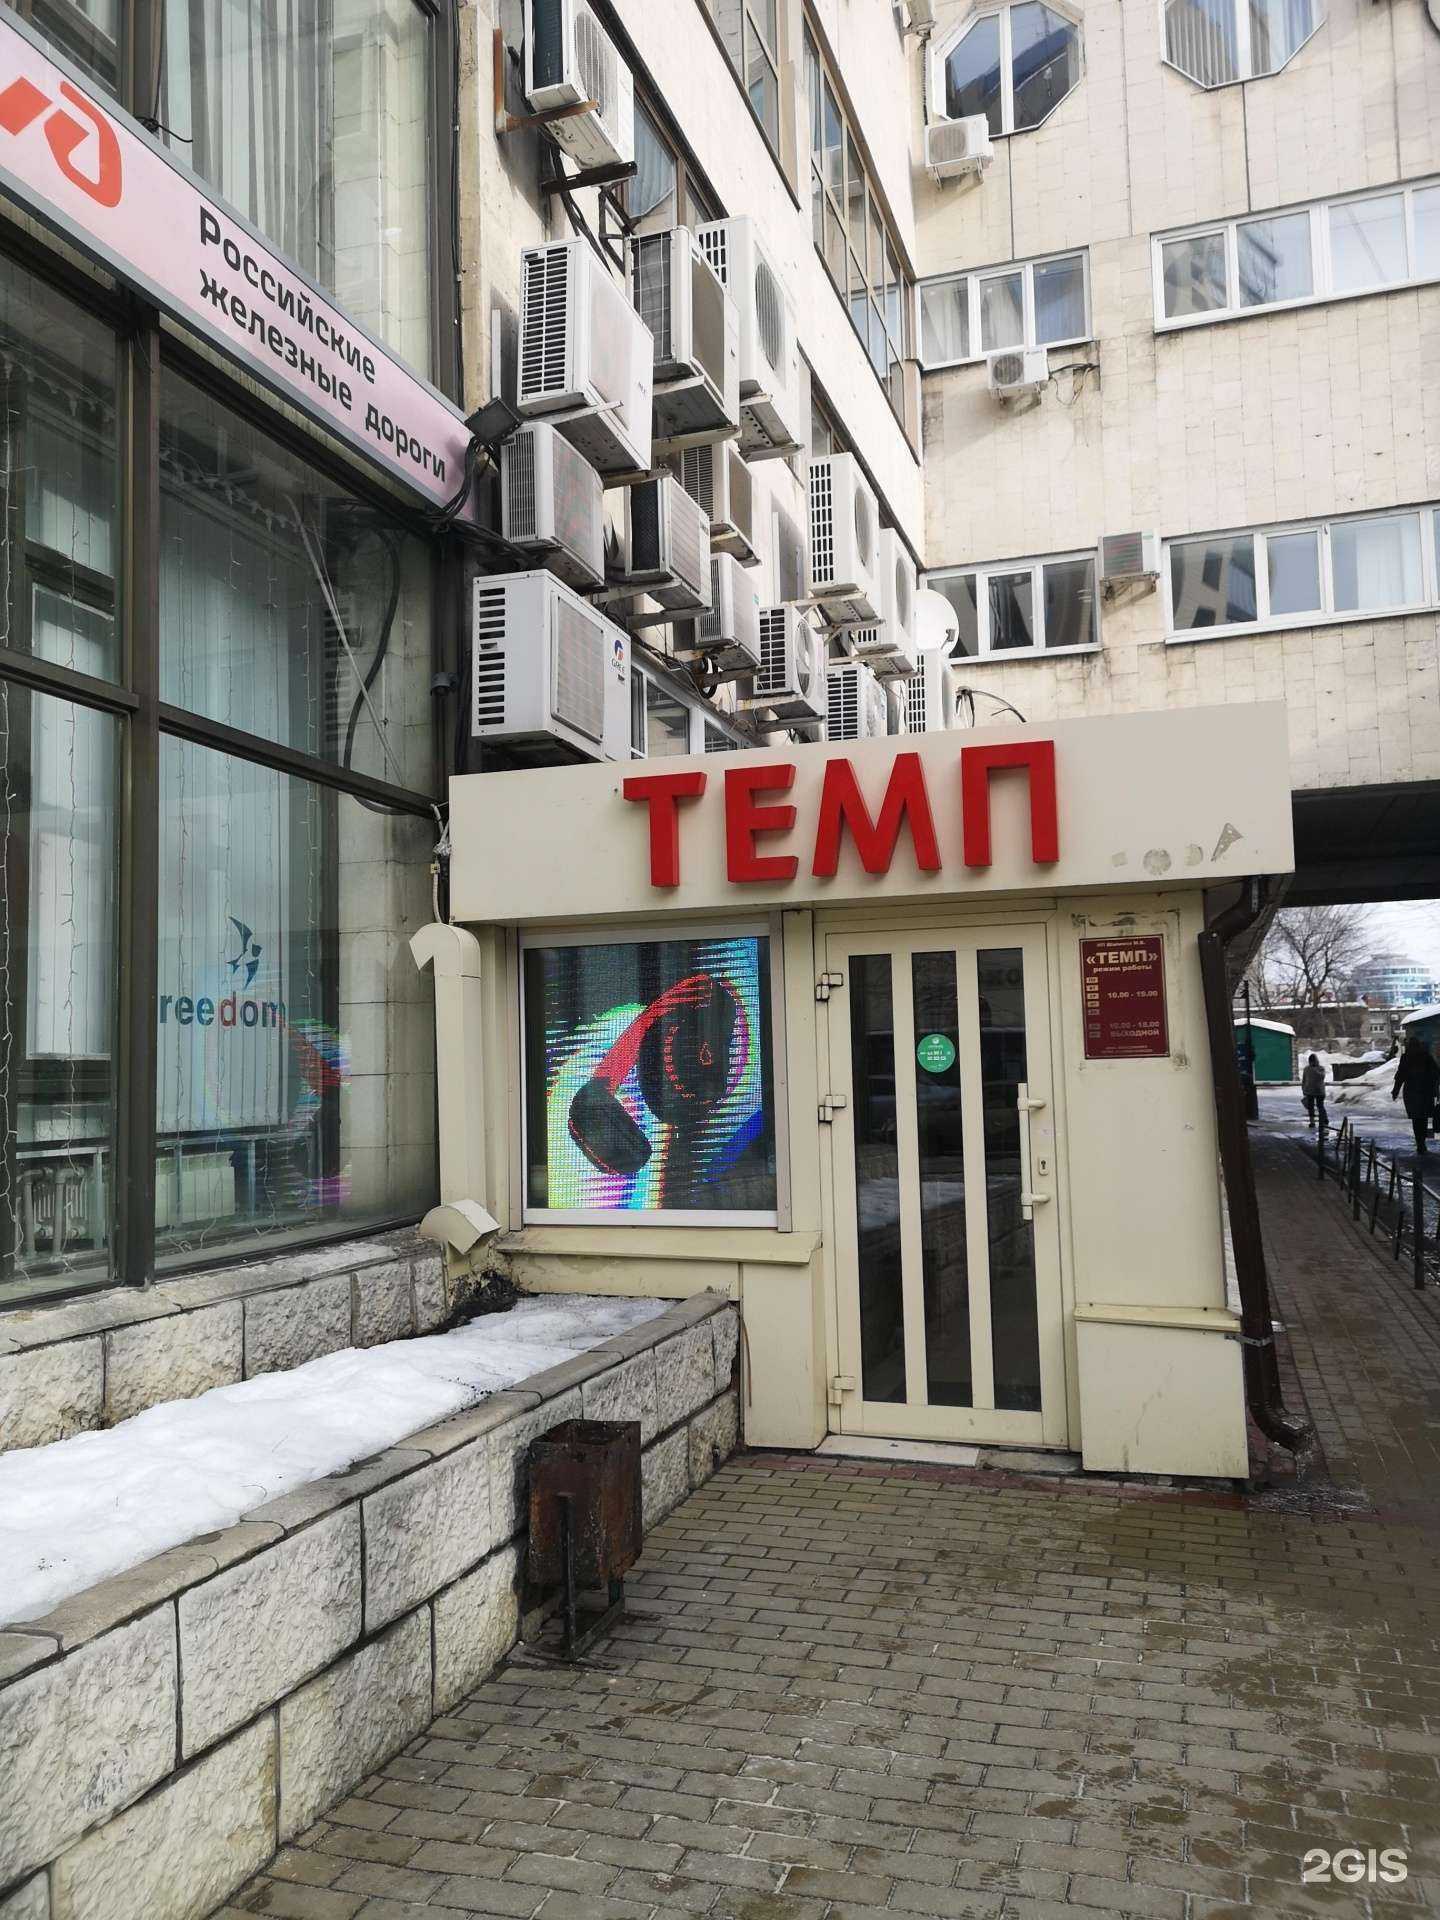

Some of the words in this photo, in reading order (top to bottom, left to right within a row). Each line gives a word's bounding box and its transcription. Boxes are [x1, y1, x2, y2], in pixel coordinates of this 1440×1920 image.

[199, 205, 376, 384] Российские
[199, 268, 352, 411] железные
[365, 402, 446, 482] дороги
[623, 740, 1059, 888] ТЕМП
[1086, 950, 1159, 965] «ТЕМП»
